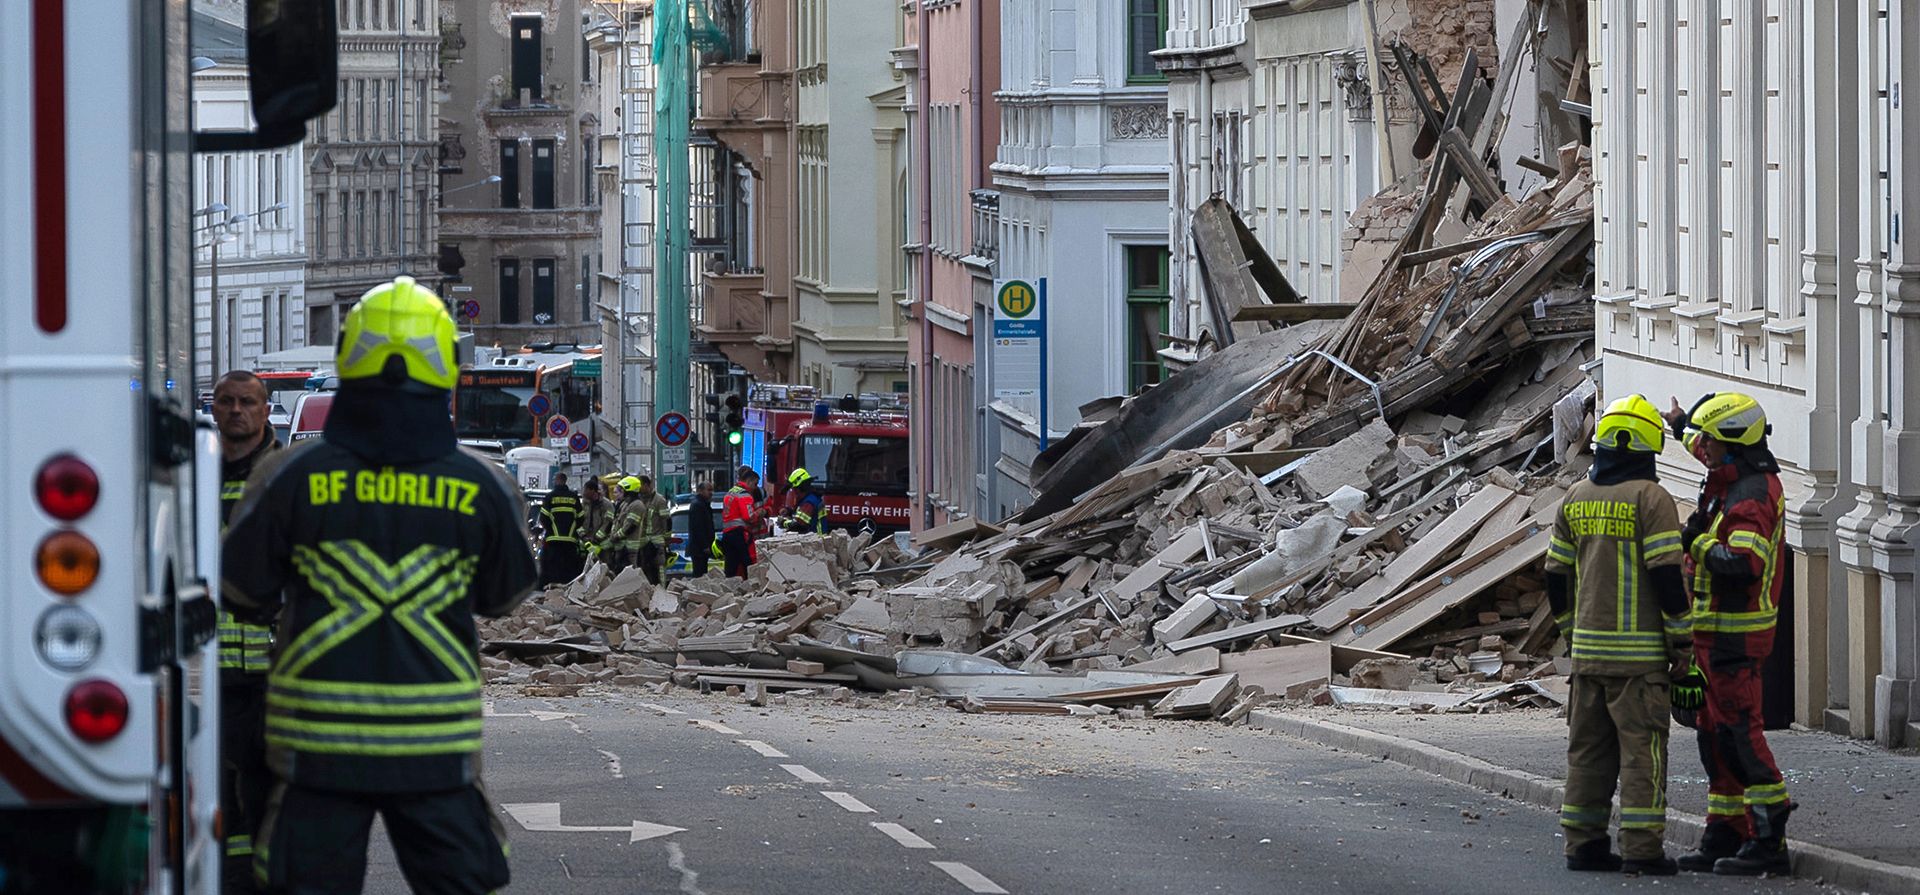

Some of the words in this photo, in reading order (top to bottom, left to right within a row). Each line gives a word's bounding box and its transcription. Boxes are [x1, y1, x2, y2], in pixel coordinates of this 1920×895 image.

[1009, 289, 1024, 309] H
[309, 470, 348, 505] BF
[355, 466, 480, 516] GÖRLITZ
[825, 505, 911, 517] FEUERWEHR
[1564, 501, 1637, 520] FREIWILLIGE
